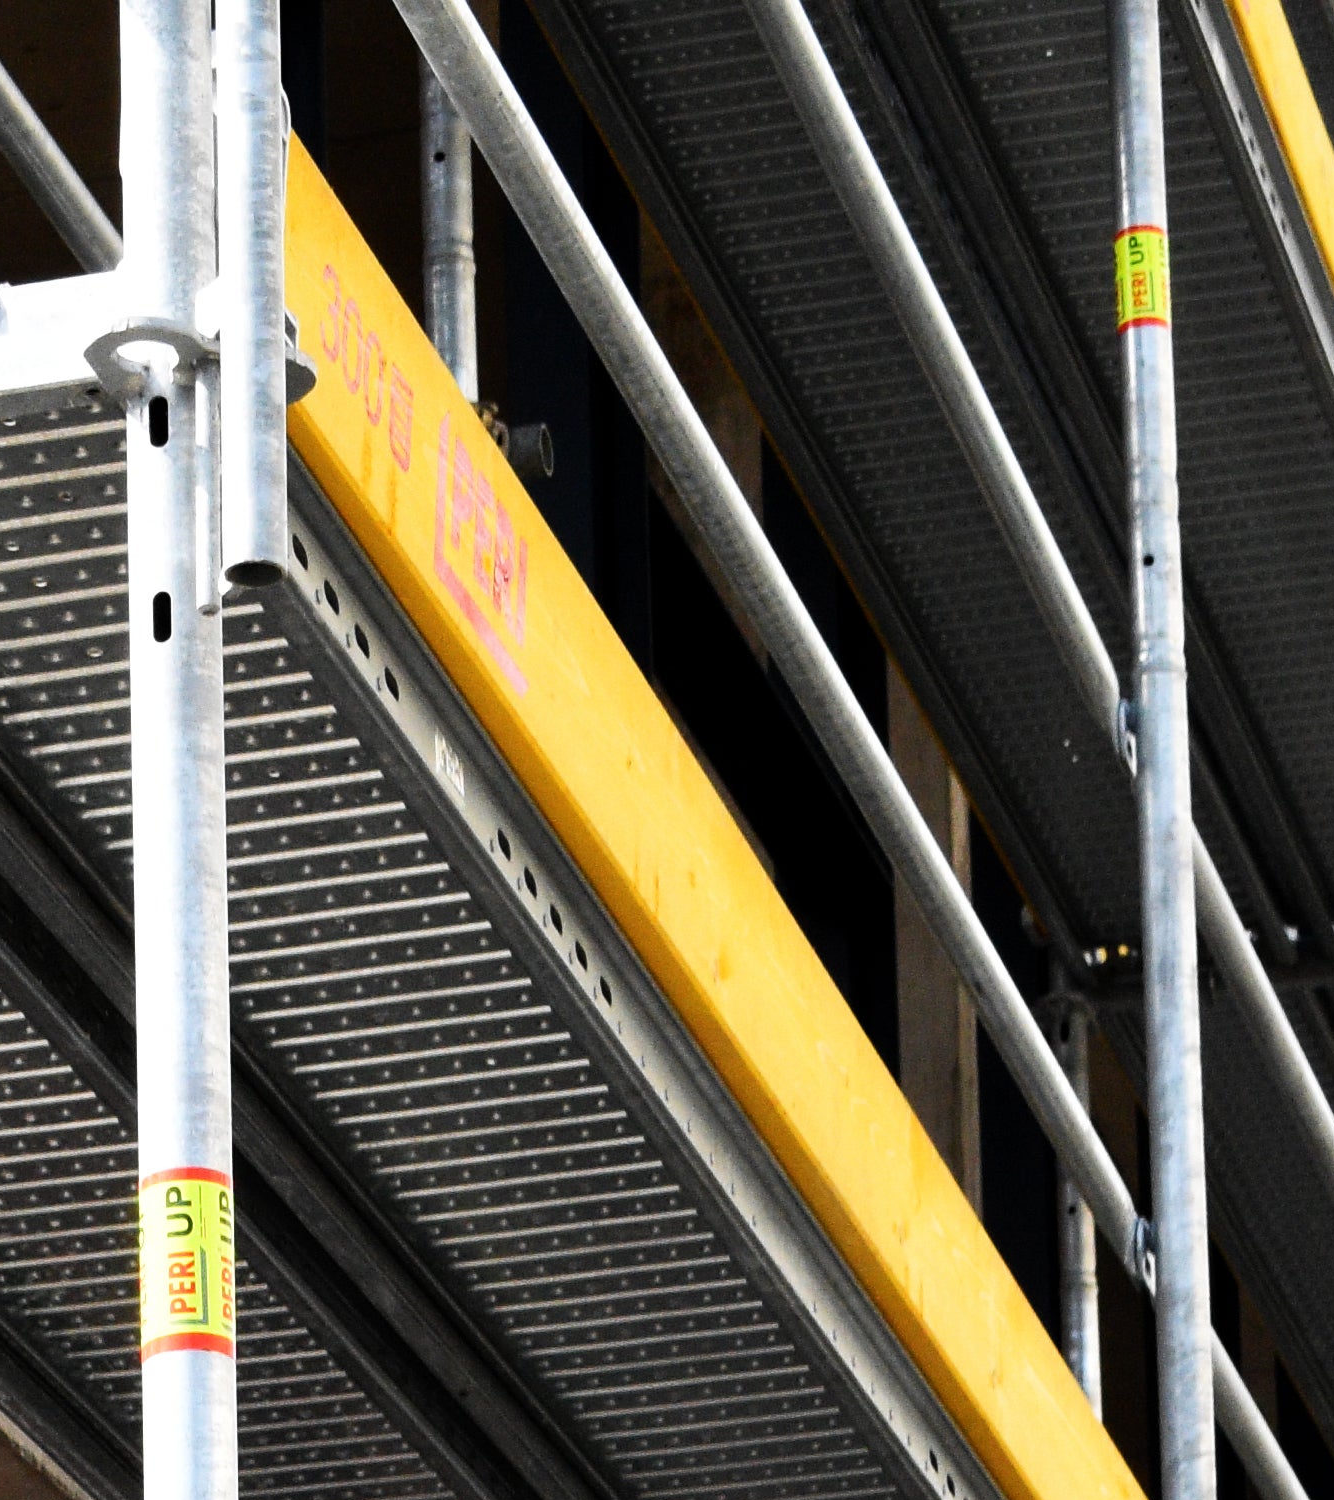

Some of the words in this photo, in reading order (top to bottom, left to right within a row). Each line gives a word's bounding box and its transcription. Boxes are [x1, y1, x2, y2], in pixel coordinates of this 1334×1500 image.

[1129, 236, 1146, 266] UP
[320, 264, 386, 426] 300
[451, 434, 528, 648] PERI
[165, 1186, 194, 1238] UP
[168, 1251, 197, 1315] PERI
